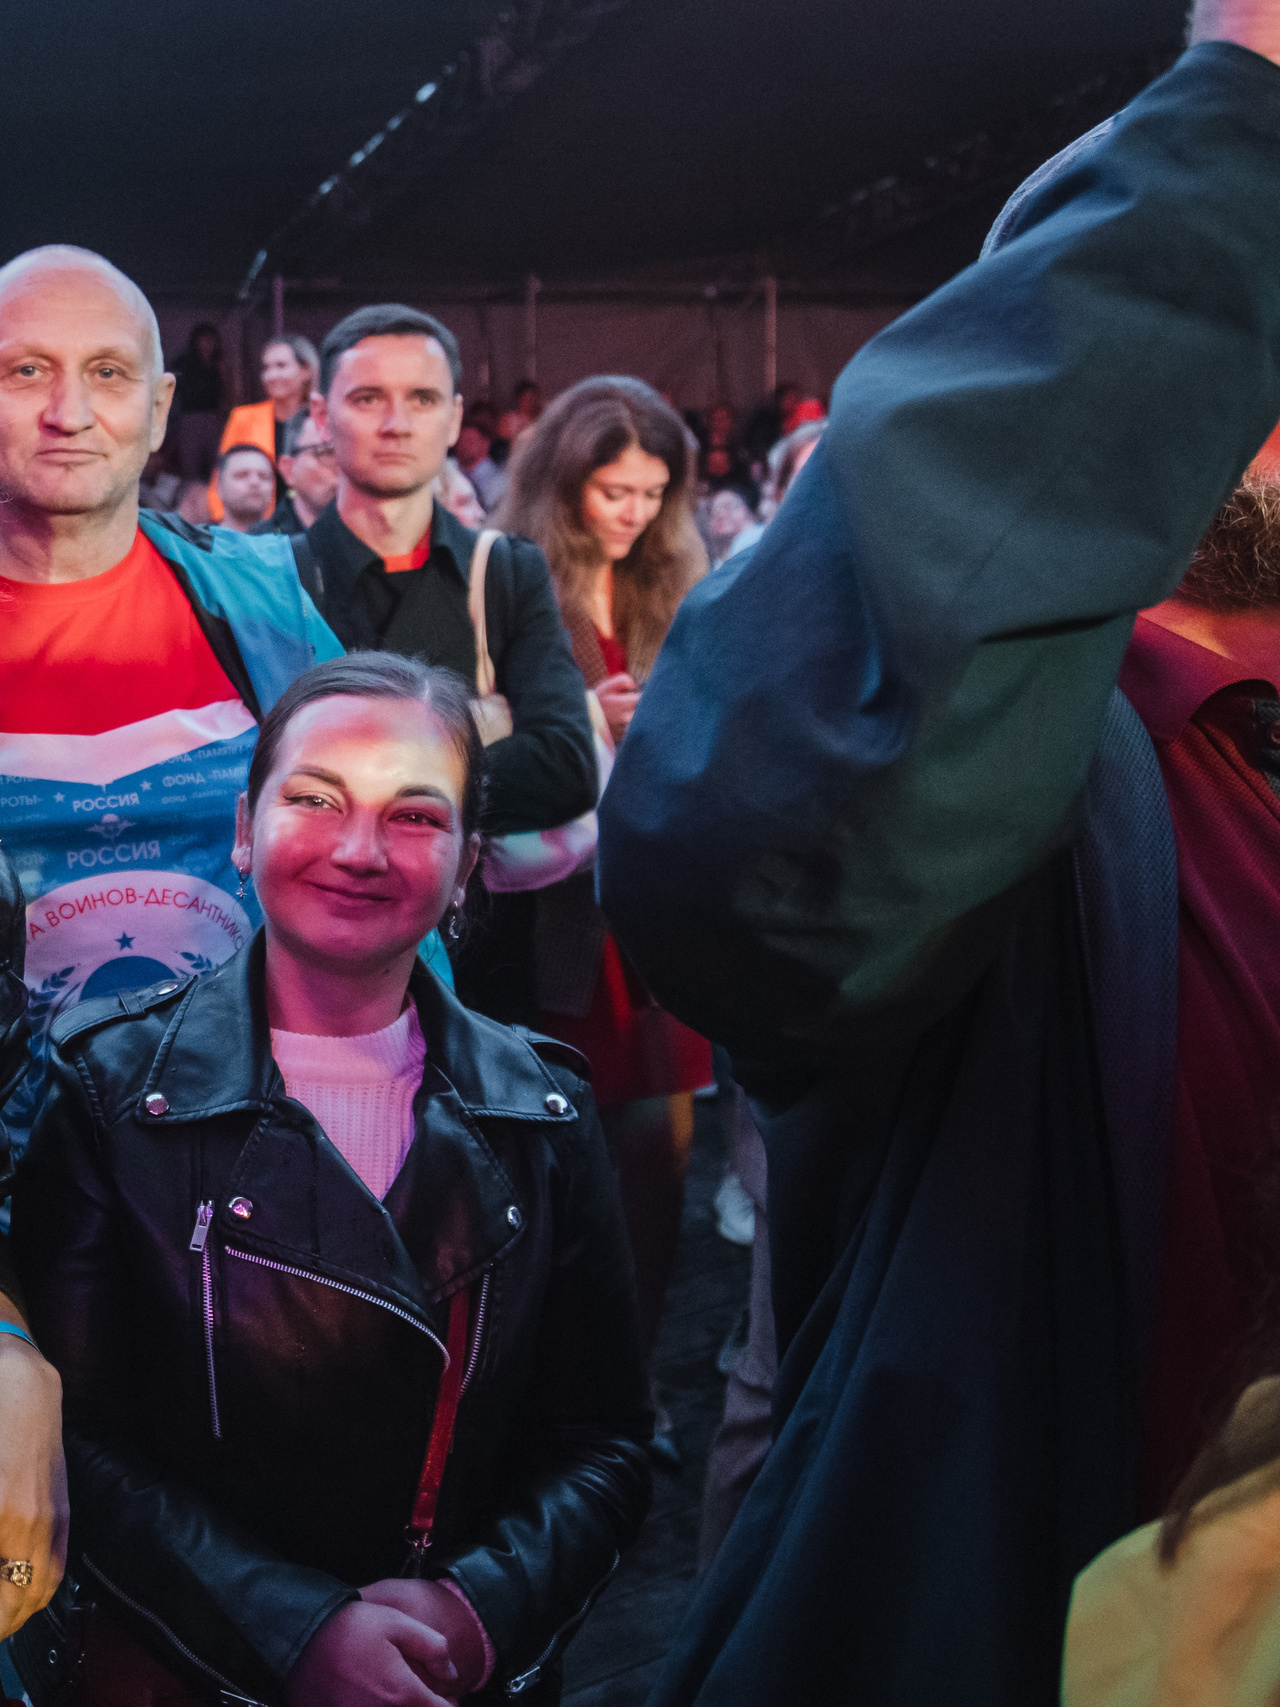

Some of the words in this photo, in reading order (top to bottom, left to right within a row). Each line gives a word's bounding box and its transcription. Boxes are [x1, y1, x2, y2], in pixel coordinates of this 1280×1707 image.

[162, 771, 207, 788] ФОНД
[72, 792, 140, 813] РОССИЯ
[66, 839, 161, 870] РОССИЯ
[45, 887, 246, 951] ВОИНОВ-ДЕСАНТНИКО
